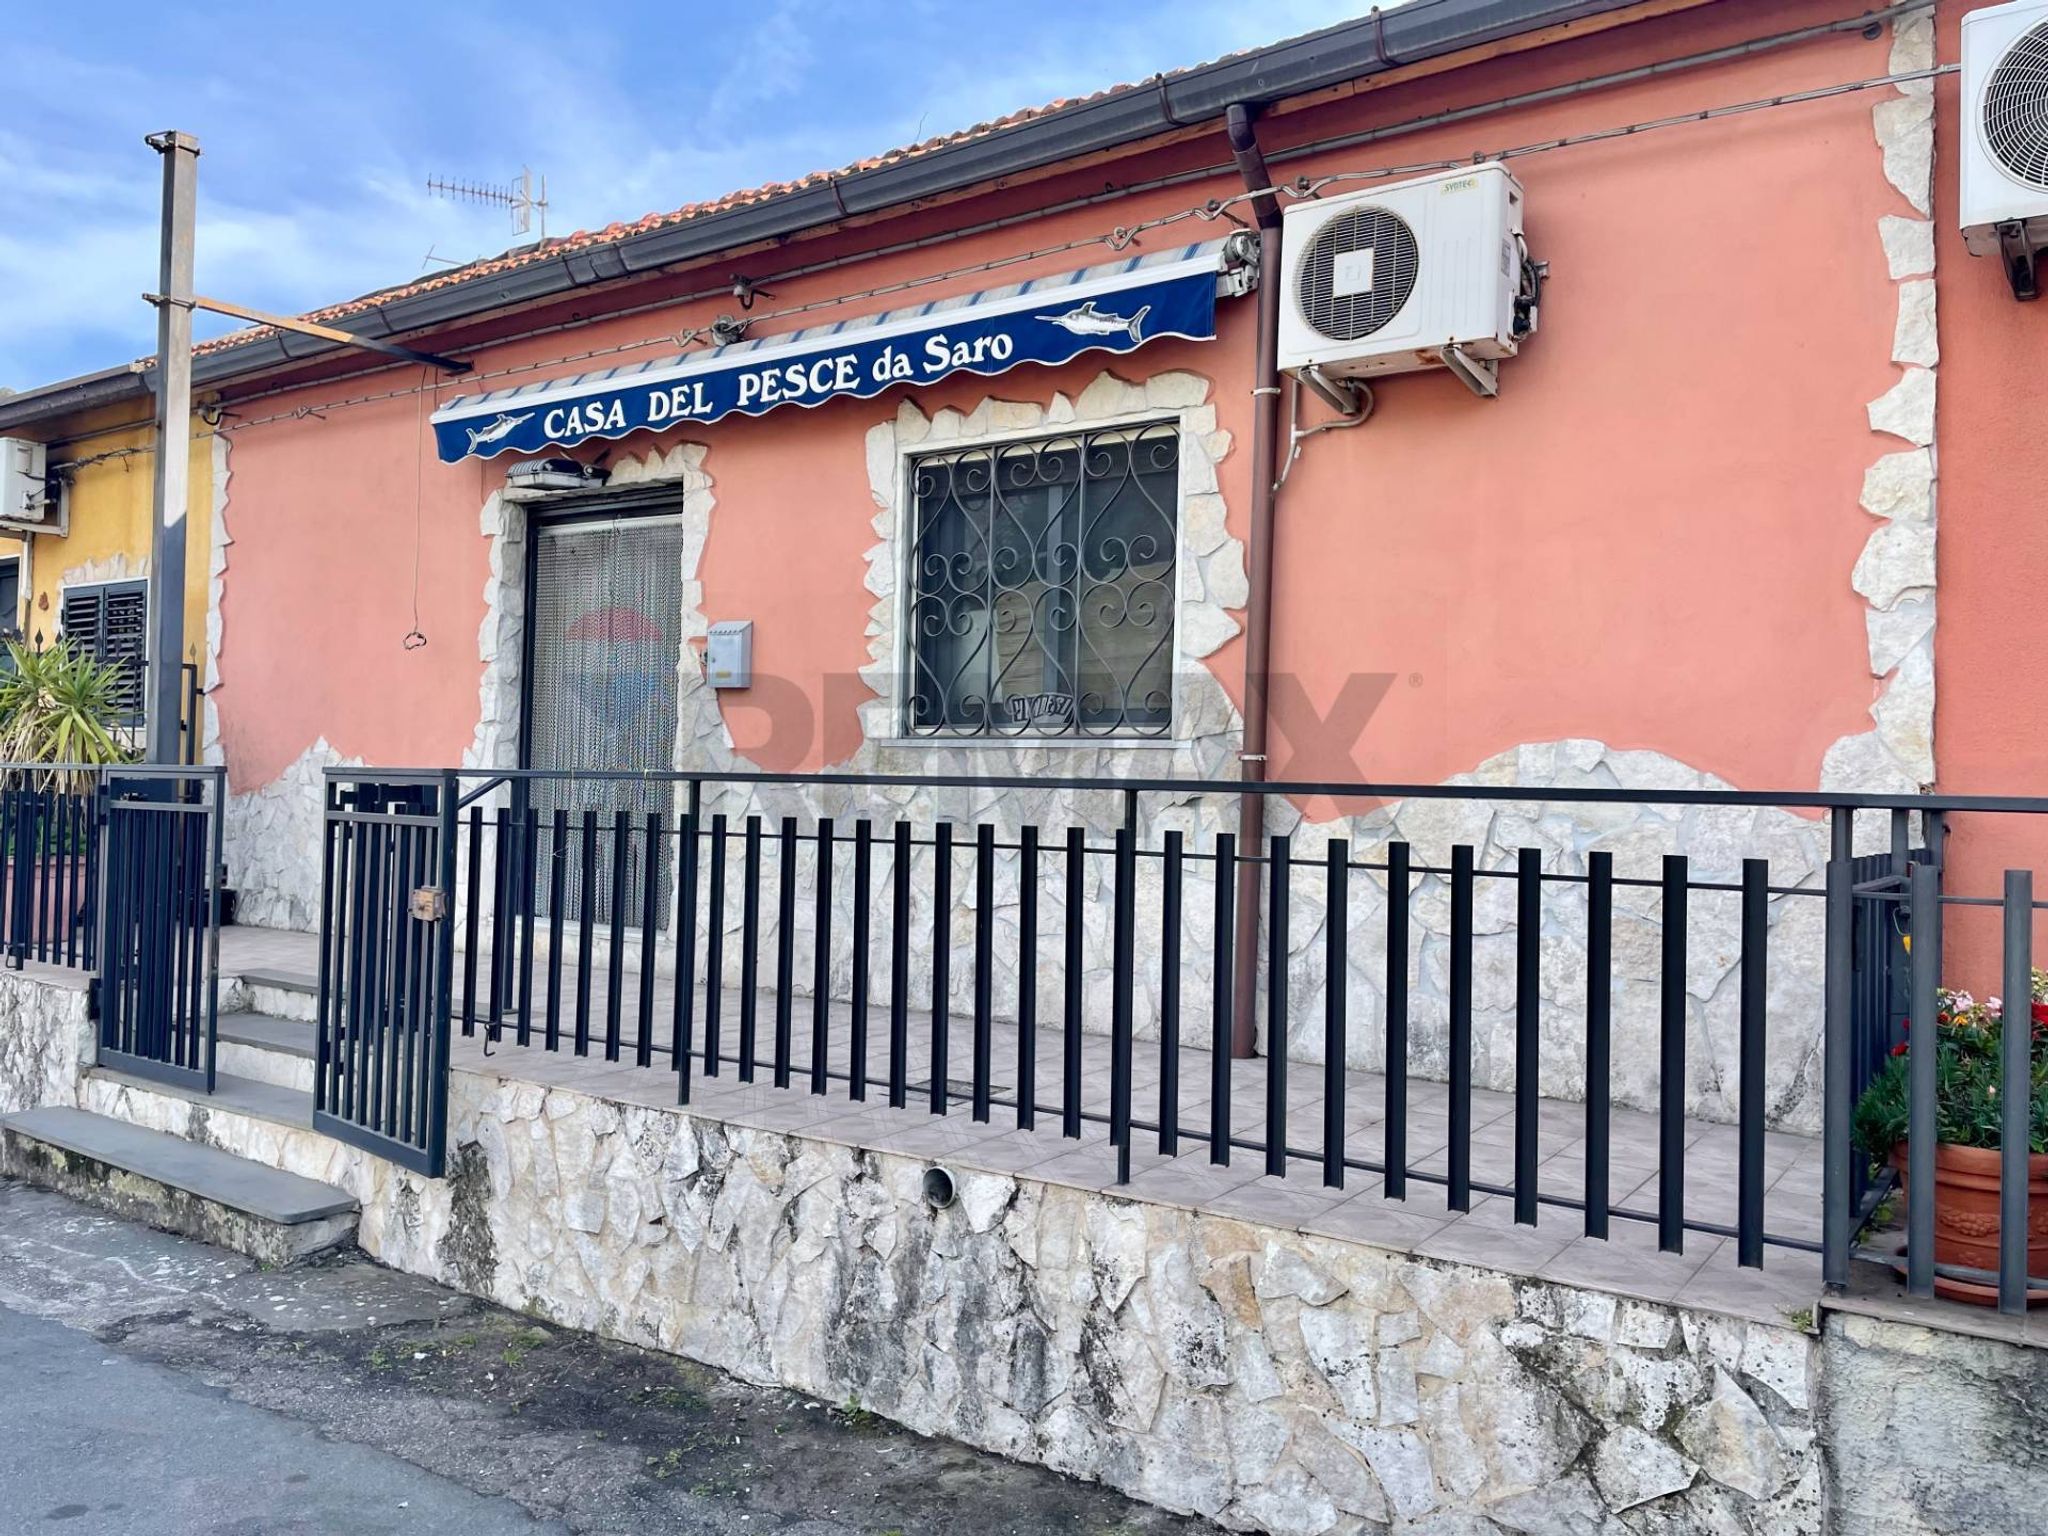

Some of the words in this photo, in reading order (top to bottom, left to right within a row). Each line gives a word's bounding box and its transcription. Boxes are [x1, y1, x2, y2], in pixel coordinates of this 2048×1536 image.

[543, 399, 627, 439] CASA
[647, 382, 714, 422] DEL
[736, 353, 861, 407] PESCE
[872, 344, 914, 382] da
[922, 332, 1014, 374] Saro
